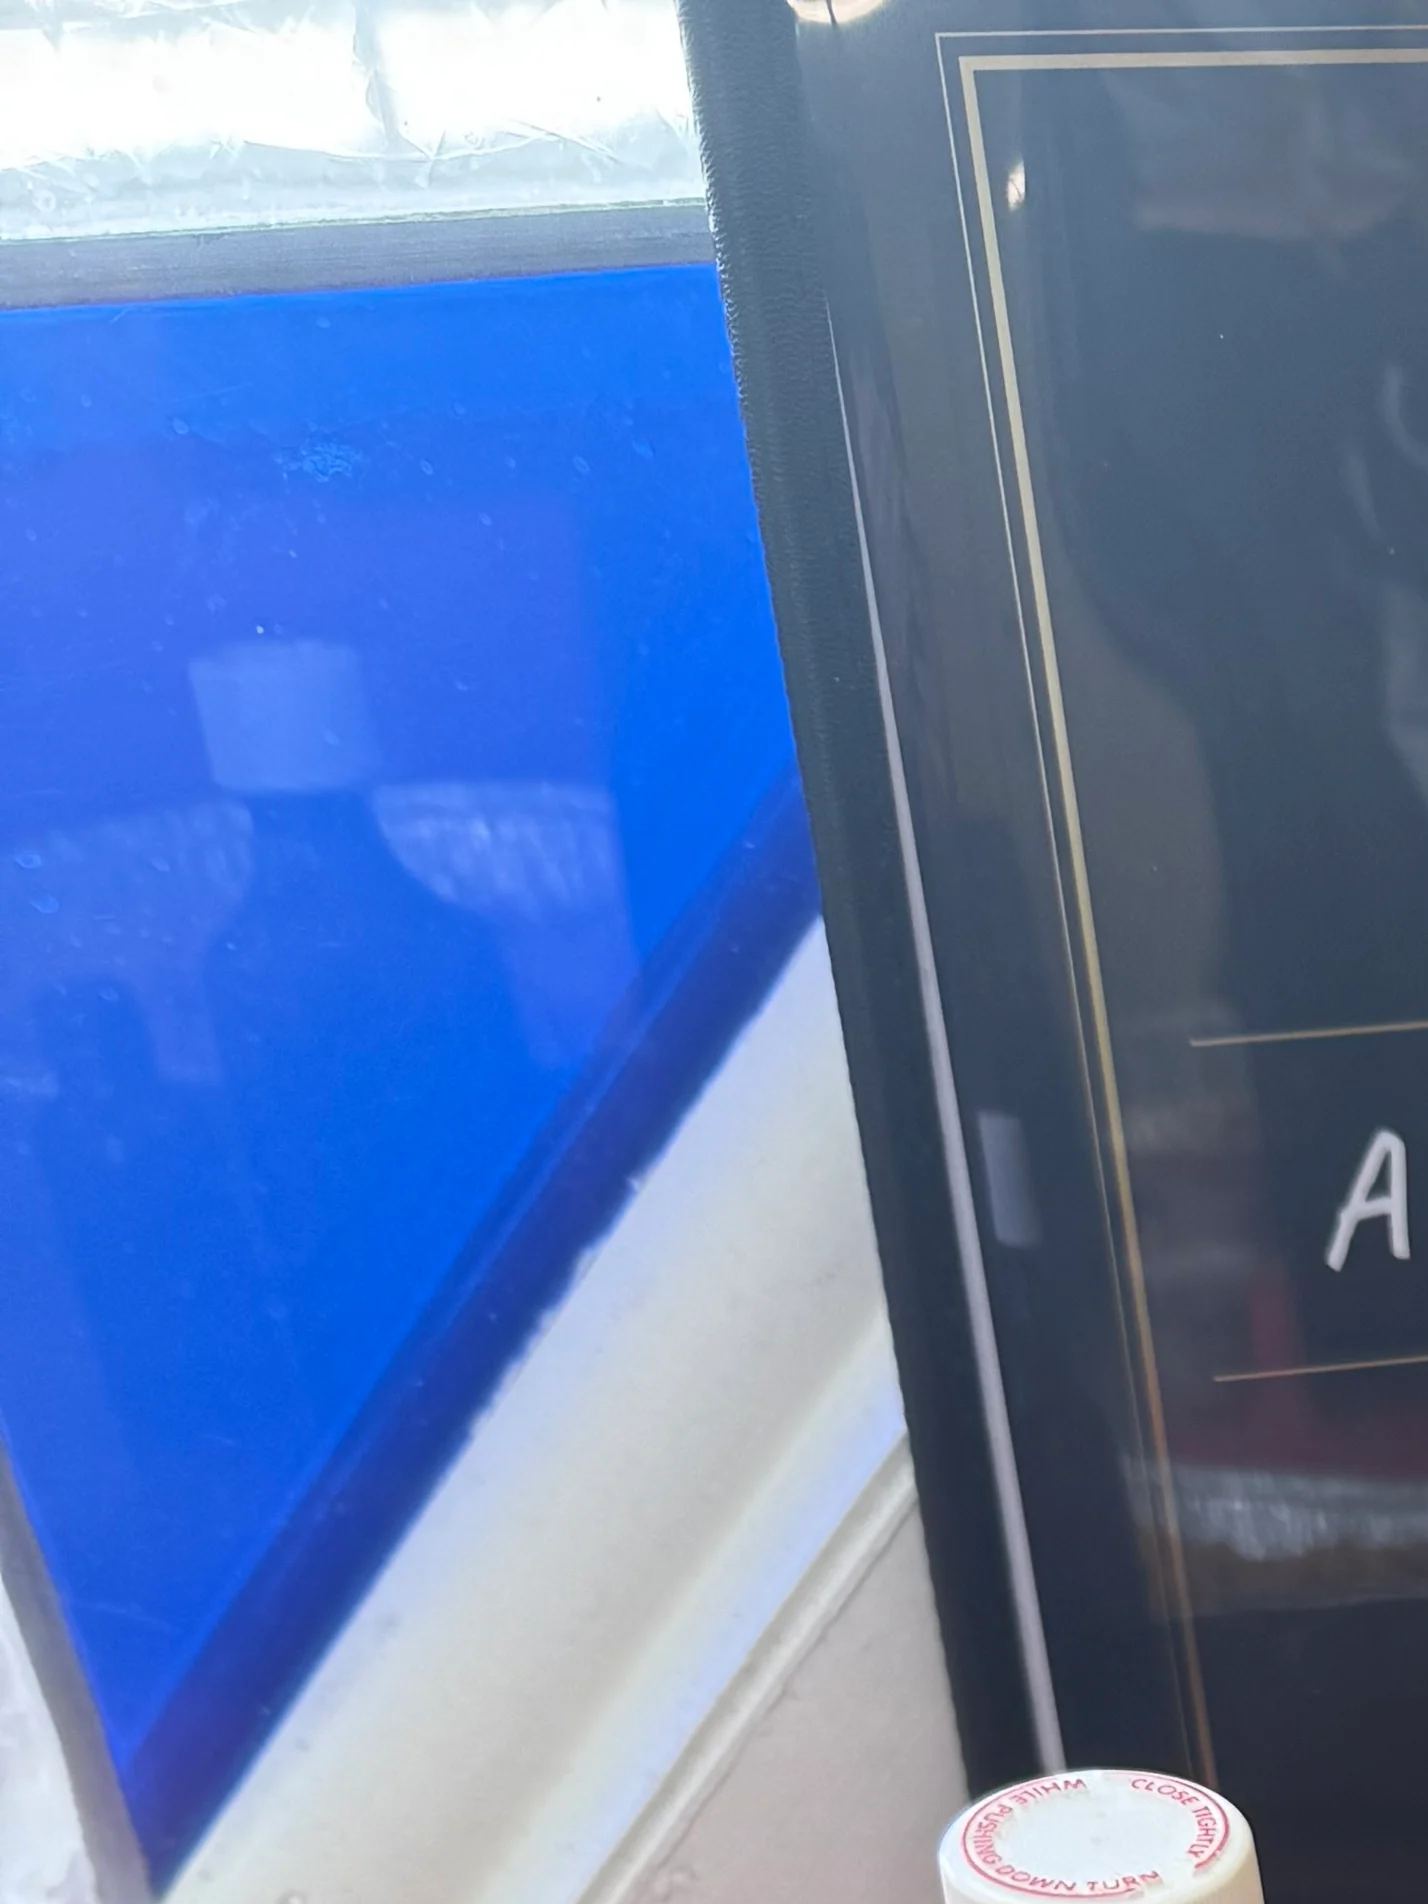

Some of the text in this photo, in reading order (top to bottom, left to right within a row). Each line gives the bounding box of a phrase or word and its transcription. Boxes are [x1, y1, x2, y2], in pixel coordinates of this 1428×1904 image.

[1324, 1129, 1410, 1271] A
[973, 1777, 1161, 1892] WHILE PUSHING DOWN TURN
[1131, 1777, 1217, 1859] CLOSE TIGHTLY
